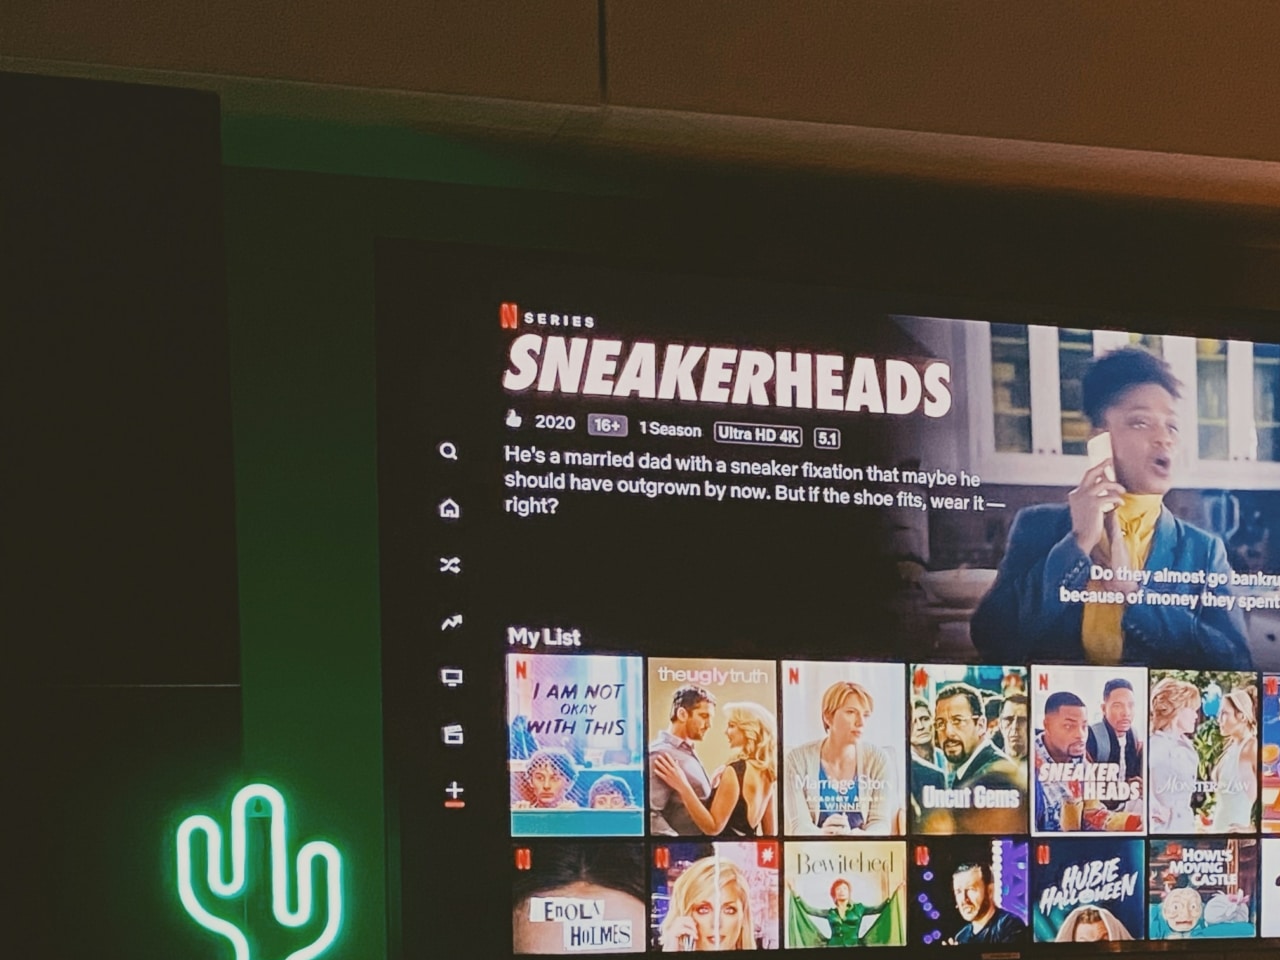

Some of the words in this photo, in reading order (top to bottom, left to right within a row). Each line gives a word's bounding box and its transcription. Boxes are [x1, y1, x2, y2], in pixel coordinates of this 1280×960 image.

[524, 312, 595, 328] SERIES
[503, 333, 951, 418] SNEAKERHEADS
[535, 415, 576, 429] 2020
[594, 418, 621, 432] 16+
[639, 421, 647, 434] 1
[649, 422, 702, 437] Season
[718, 426, 752, 441] Ultra
[755, 427, 776, 442] HD
[779, 429, 799, 444] 4K
[818, 431, 837, 446] 5.1
[504, 446, 546, 464] He's
[550, 451, 561, 464] a
[565, 451, 634, 468] married
[638, 453, 672, 470] dad
[675, 456, 712, 472] with
[716, 460, 727, 473] a
[731, 460, 798, 477] sneaker
[801, 462, 863, 481] fixation
[866, 465, 899, 483] that
[902, 469, 956, 488] maybe
[961, 471, 980, 487] he
[504, 472, 565, 490] should
[570, 474, 613, 492] have
[617, 478, 701, 498] outgrown
[705, 481, 727, 501] by
[731, 485, 771, 500] now.
[775, 486, 805, 502] But
[808, 487, 821, 502] if
[823, 488, 850, 504] the
[853, 489, 894, 506] shoe
[897, 491, 927, 511] fits,
[930, 496, 970, 510] wear
[505, 497, 559, 516] right?
[1091, 566, 1113, 582] Do
[1117, 567, 1151, 585] they
[1153, 568, 1206, 584] almost
[1208, 572, 1228, 588] go
[1060, 586, 1124, 604] because
[1127, 588, 1144, 604] of
[1147, 592, 1199, 610] money
[1201, 591, 1235, 611] they
[1238, 594, 1280, 611] spent
[507, 627, 540, 649] My
[544, 628, 581, 646] List
[532, 683, 540, 700] I
[547, 684, 578, 700] AM
[585, 684, 625, 700] NOT
[560, 703, 597, 715] OKAY
[527, 719, 576, 735] WITH
[585, 719, 627, 736] THIS
[1038, 762, 1120, 782] SNEAKER
[922, 785, 971, 809] Uncut
[974, 785, 1020, 809] Gems
[1084, 781, 1140, 801] HEADS
[797, 851, 894, 876] Bewitched
[1182, 848, 1234, 863] HOWL'S
[1061, 857, 1121, 891] HUBIE
[1169, 860, 1224, 875] MOVING
[1190, 873, 1238, 887] CASTLE
[1039, 872, 1138, 916] HALLOWEEN
